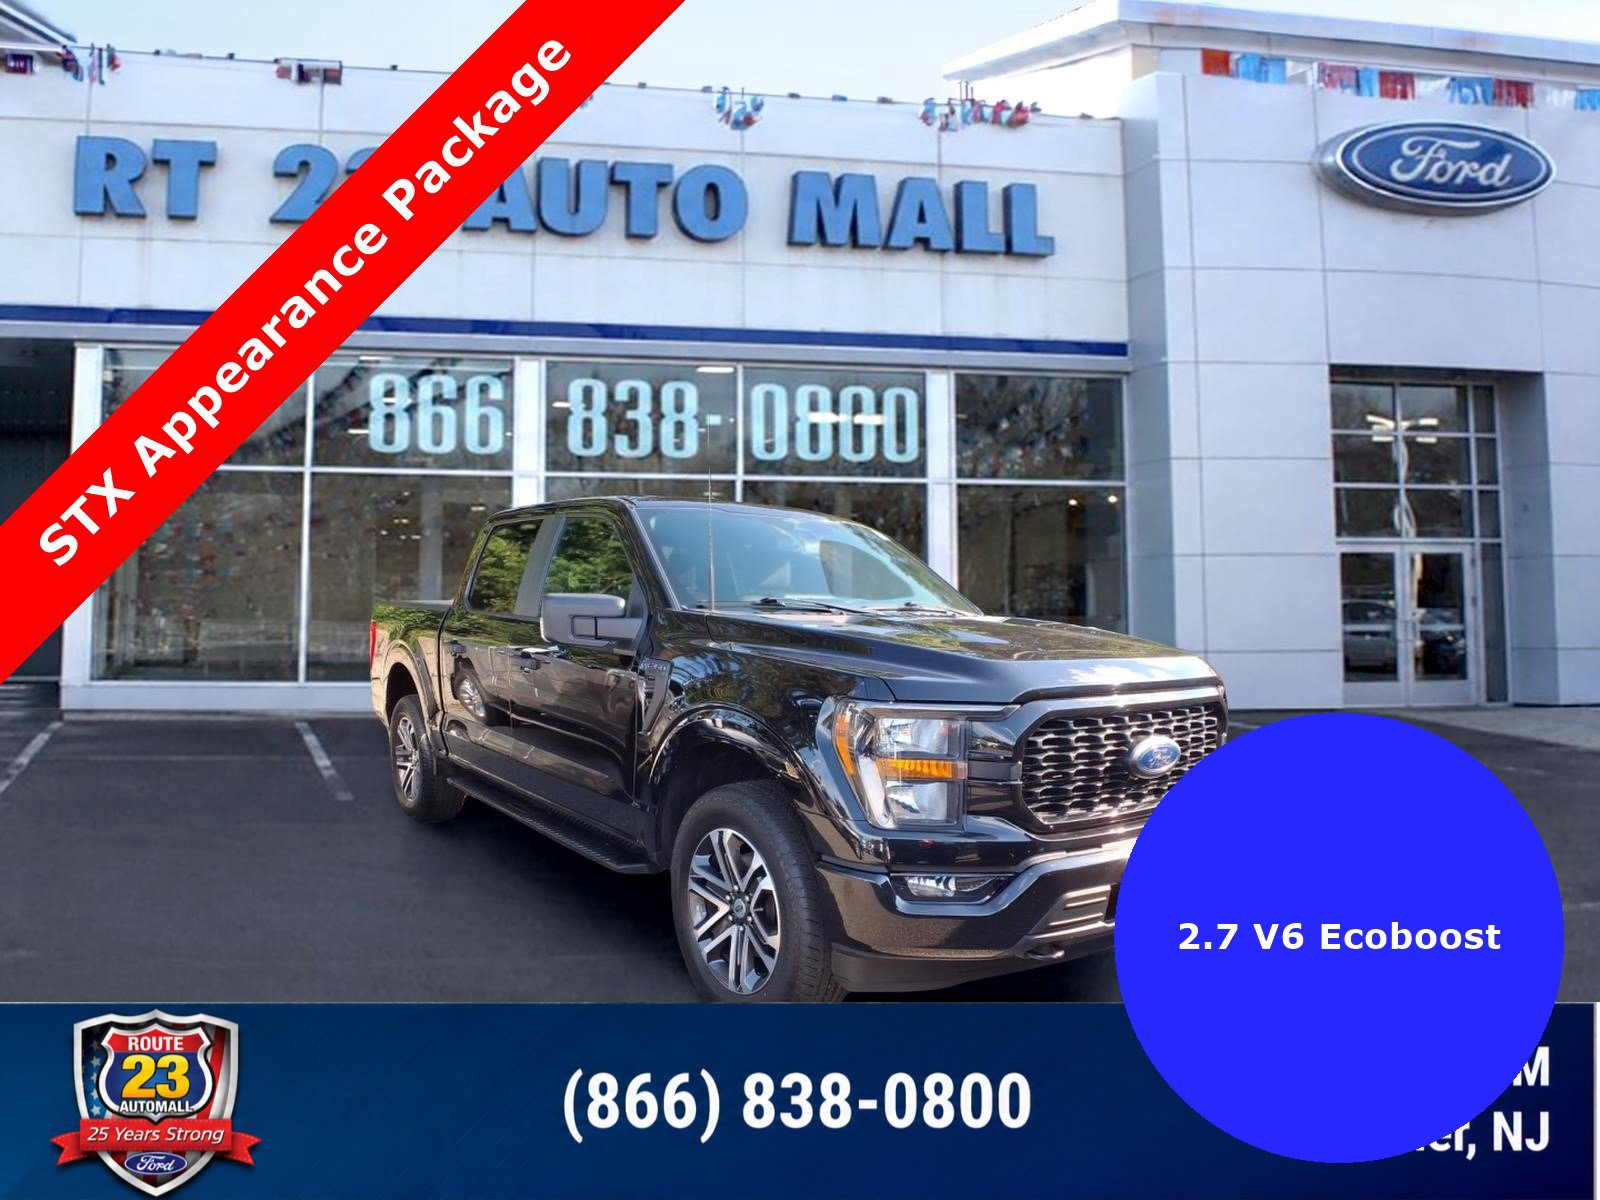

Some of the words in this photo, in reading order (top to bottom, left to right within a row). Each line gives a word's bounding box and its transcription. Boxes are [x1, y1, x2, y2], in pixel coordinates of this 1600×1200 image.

[74, 136, 217, 220] RT
[269, 144, 381, 224] 2
[462, 157, 748, 243] AUTO
[787, 170, 1055, 257] MALL
[1389, 135, 1513, 188] Ford
[369, 373, 505, 454] 866
[751, 383, 919, 463] 0800
